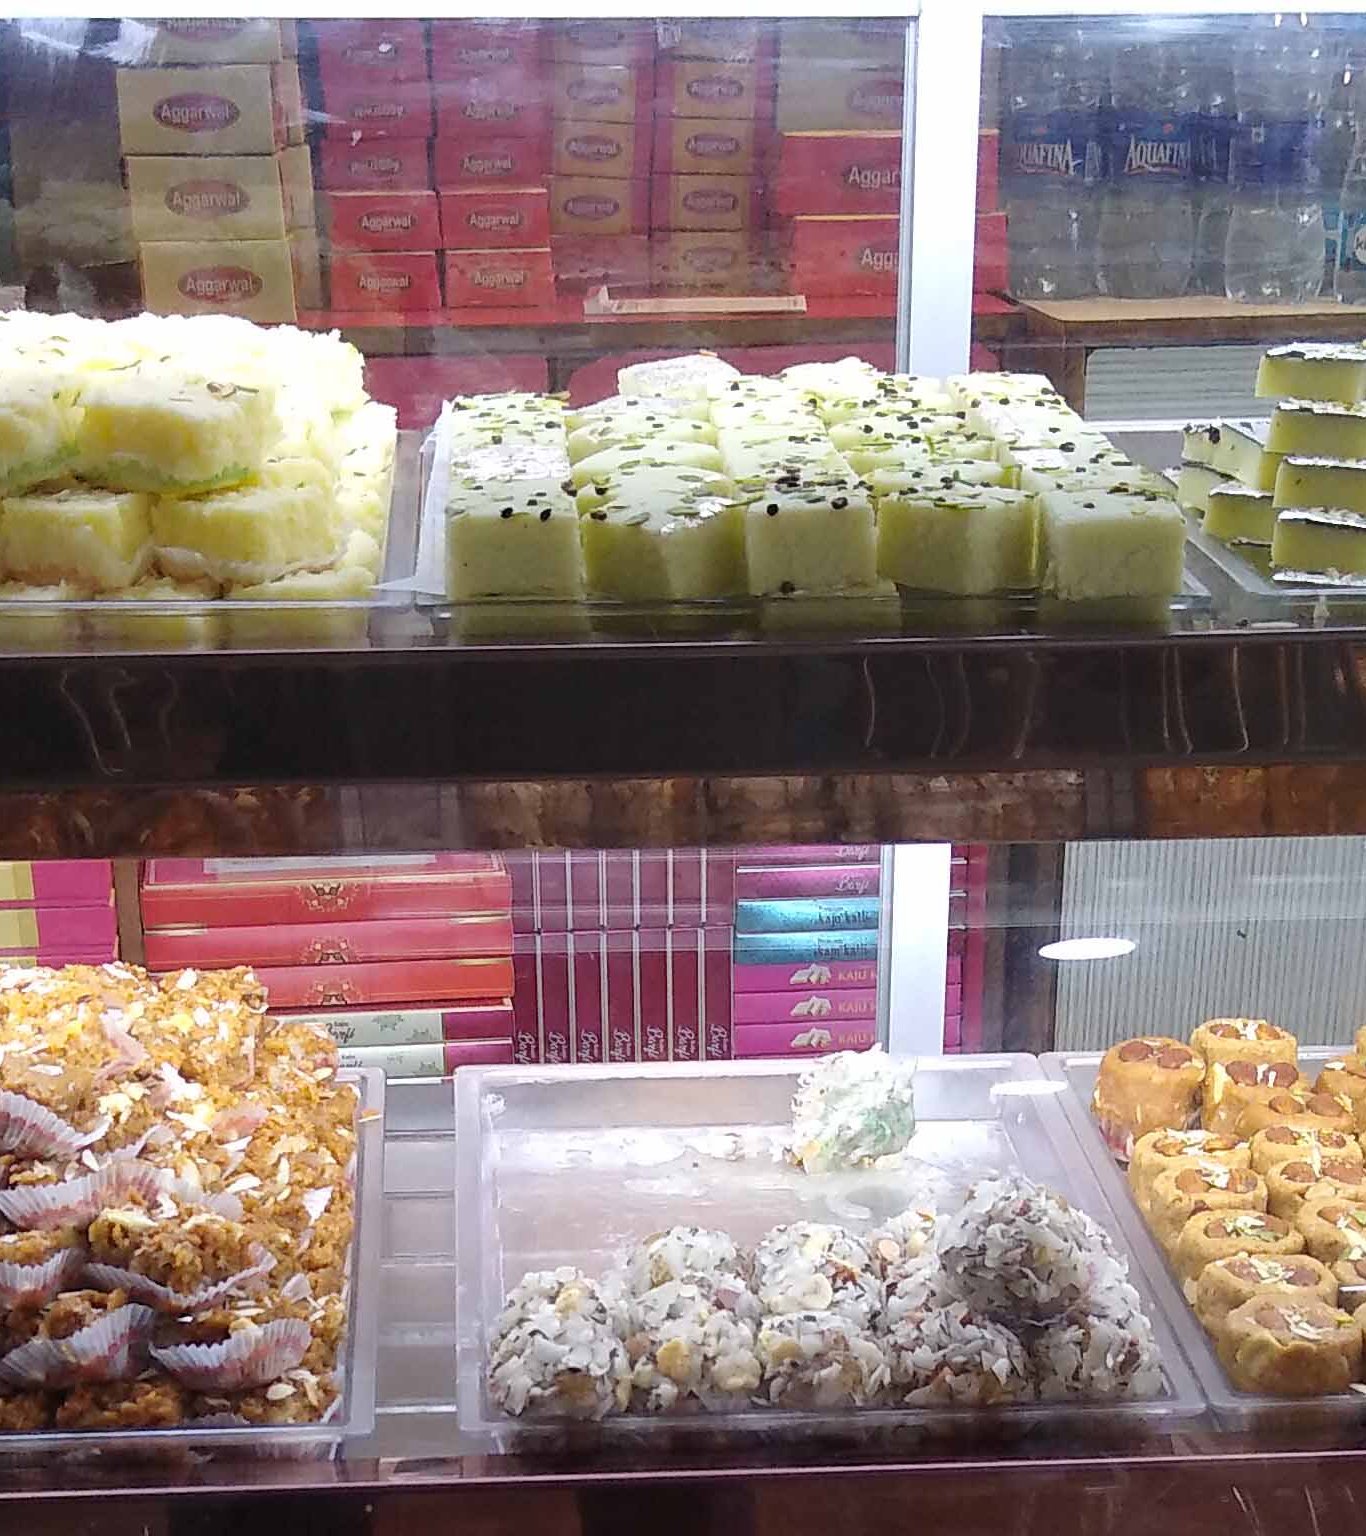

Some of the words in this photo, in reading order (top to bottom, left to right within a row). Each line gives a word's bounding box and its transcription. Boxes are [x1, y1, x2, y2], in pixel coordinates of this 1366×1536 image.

[161, 104, 229, 123] Aggarwal
[848, 166, 901, 188] Aggar
[186, 276, 252, 297] Aggarwal
